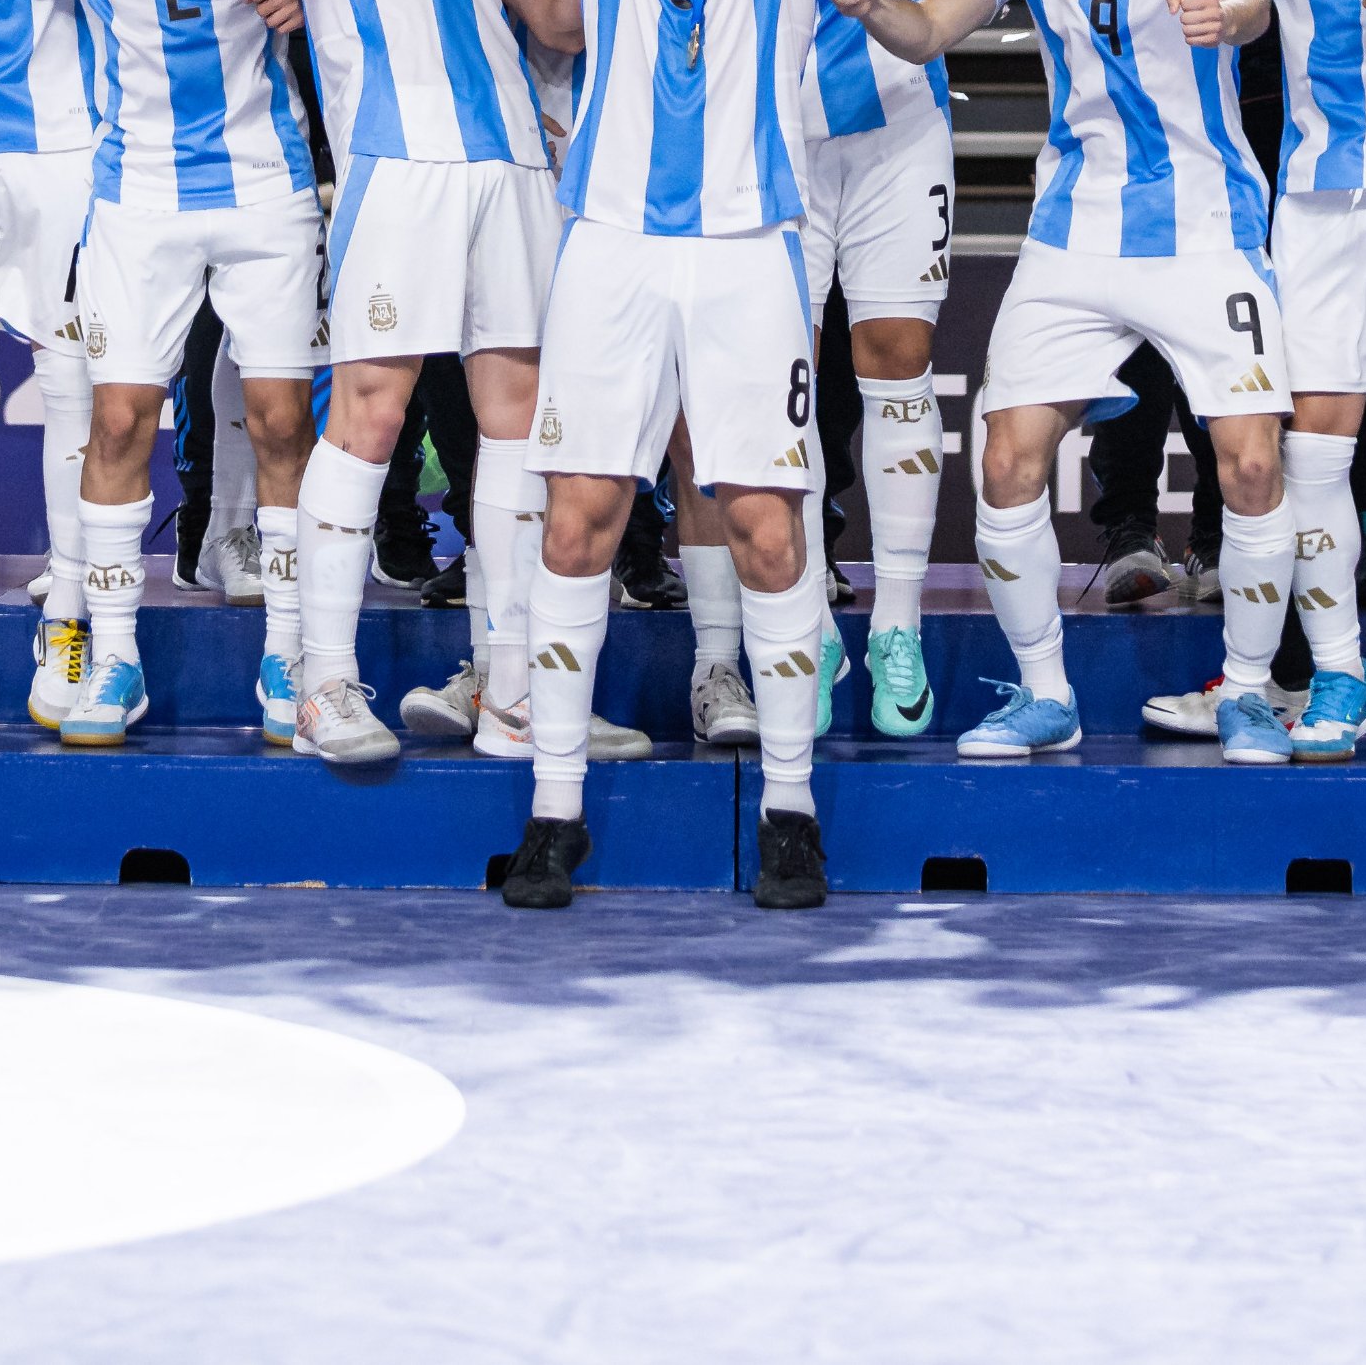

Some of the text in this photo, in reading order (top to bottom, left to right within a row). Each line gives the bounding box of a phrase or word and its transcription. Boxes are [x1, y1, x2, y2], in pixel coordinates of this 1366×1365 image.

[929, 183, 951, 252] 3
[1225, 291, 1265, 355] 9
[786, 357, 811, 428] 8
[881, 396, 934, 424] AFA
[86, 562, 137, 592] AFA
